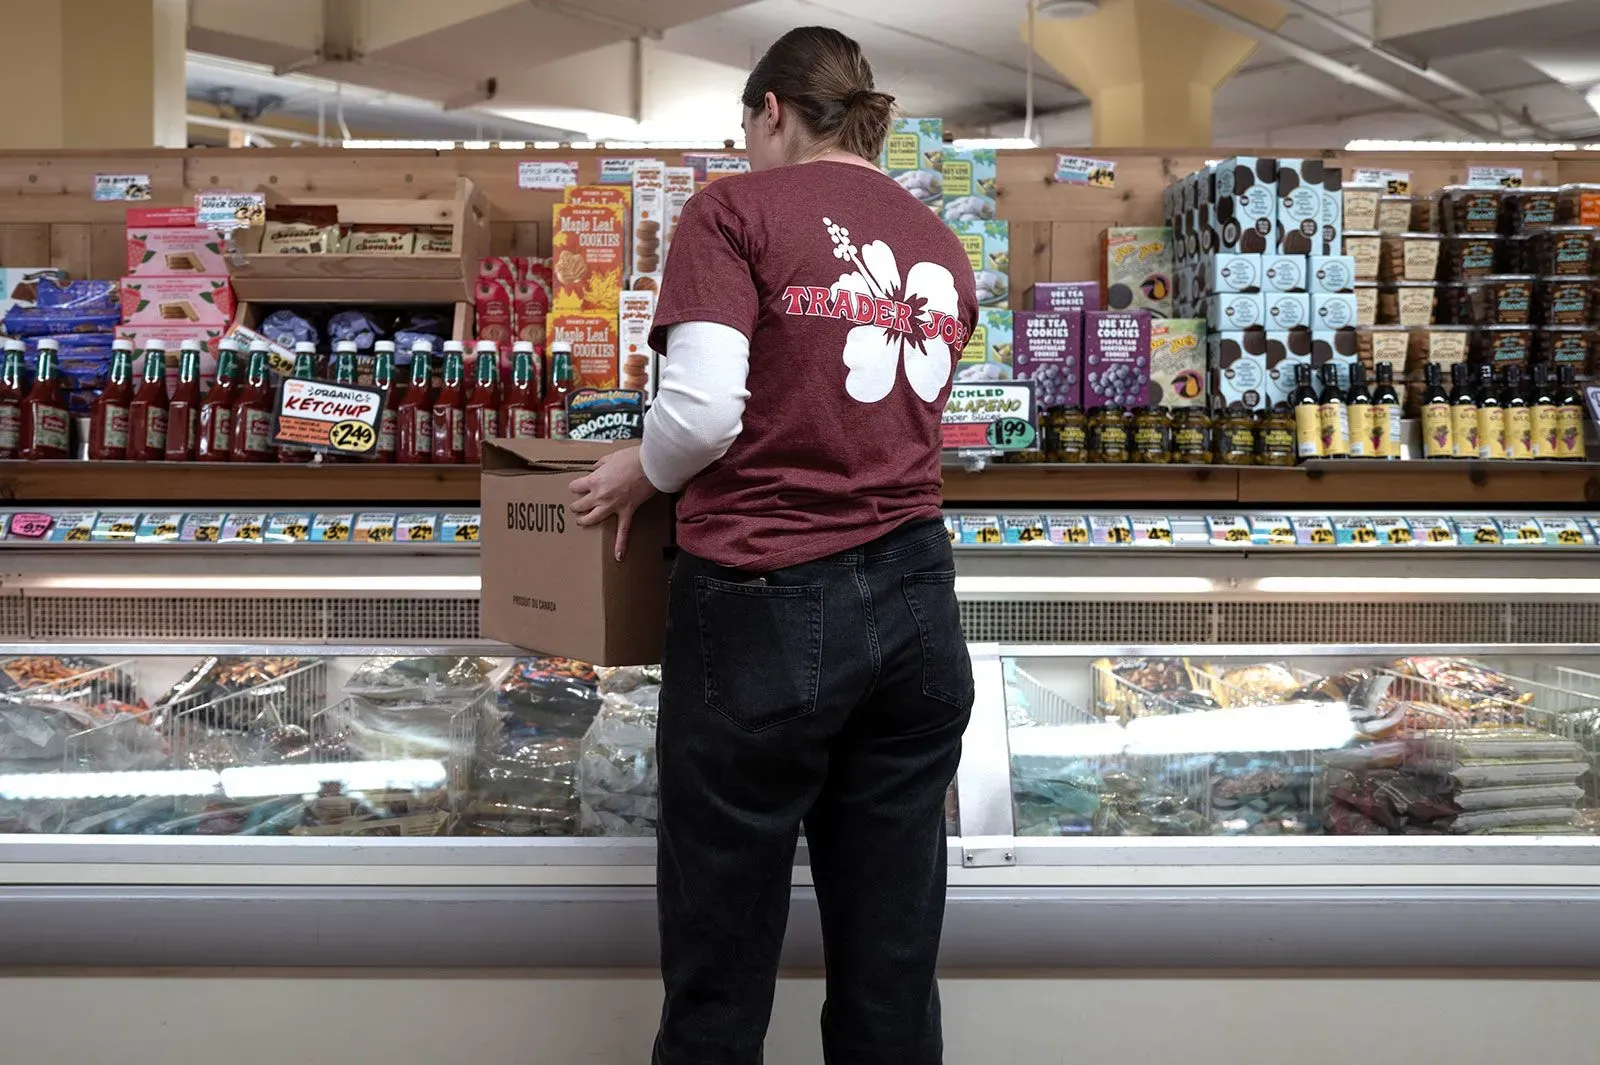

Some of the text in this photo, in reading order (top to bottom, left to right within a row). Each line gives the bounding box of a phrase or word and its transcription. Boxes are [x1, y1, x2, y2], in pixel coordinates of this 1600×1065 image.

[560, 216, 615, 235] Maple Leaf
[579, 233, 620, 247] COOKIES
[1067, 290, 1084, 298] TEA
[1050, 298, 1084, 306] COOKIES
[782, 286, 913, 333] TRADER
[1027, 319, 1068, 328] UBE TEA
[1098, 319, 1139, 328] UBE TEA
[554, 326, 609, 344] Maple Leaf
[1026, 328, 1069, 338] COOKIES
[1097, 328, 1140, 338] COOKIES
[573, 344, 615, 358] COOKIES
[313, 387, 365, 403] ORGANIC
[952, 389, 1004, 398] ICKLED
[285, 396, 372, 418] KETCHUP
[944, 399, 1022, 414] ALAPENO
[569, 412, 640, 440] BROCCOLI
[507, 502, 565, 534] BISCUITS
[512, 595, 557, 612] PRODUIT DU CANADA
